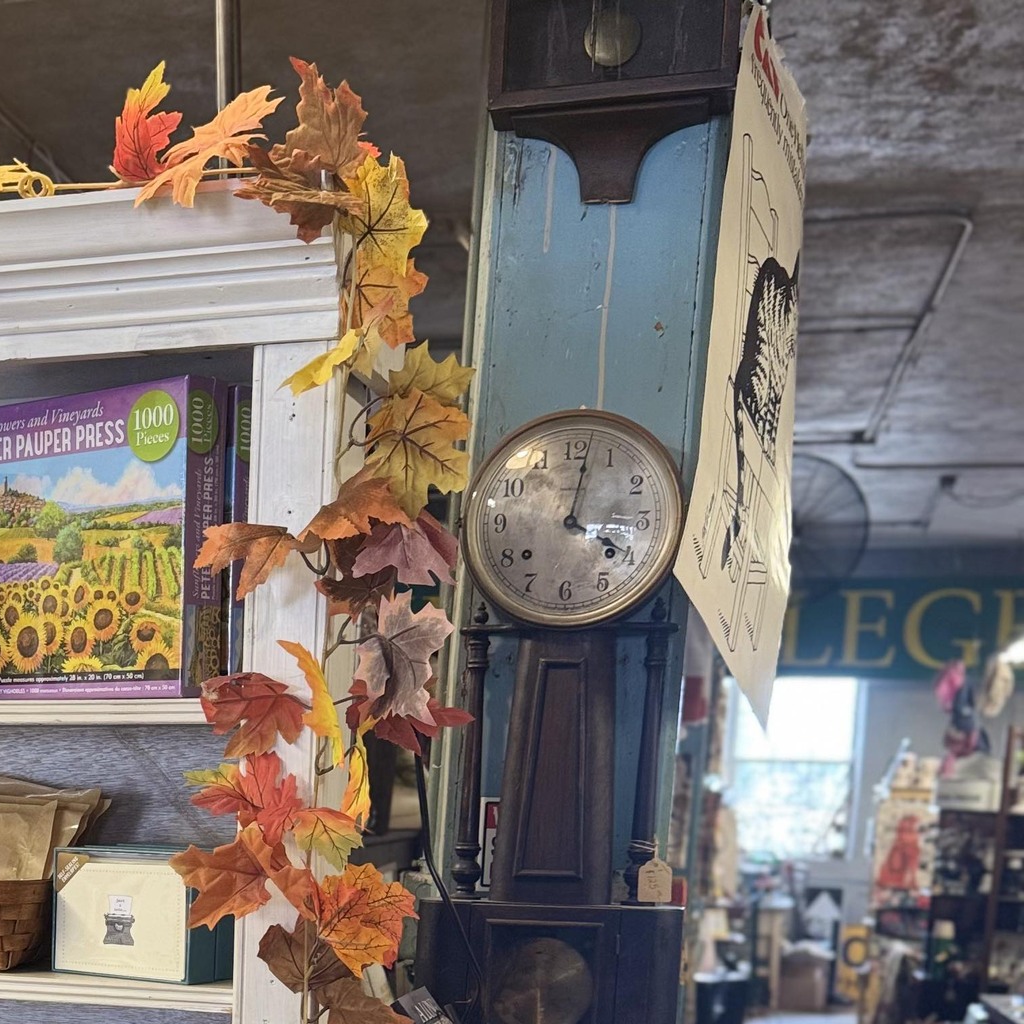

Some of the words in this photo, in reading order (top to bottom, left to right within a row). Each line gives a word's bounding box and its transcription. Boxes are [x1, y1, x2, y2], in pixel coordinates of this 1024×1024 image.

[28, 410, 48, 428] and
[51, 401, 104, 426] Vineyards
[132, 404, 174, 430] 1000
[191, 397, 204, 444] 1000
[16, 428, 72, 458] PAUPER
[76, 419, 125, 450] PRESS
[136, 431, 170, 446] Pieces
[564, 440, 587, 460] 12
[606, 448, 614, 467] 1
[204, 456, 214, 493] PRESS
[630, 475, 644, 494] 2
[503, 478, 524, 498] 10
[494, 514, 506, 534] 9
[636, 510, 650, 530] 3
[501, 549, 514, 568] 8
[622, 546, 636, 566] 4
[524, 573, 538, 592] 7
[559, 580, 572, 600] 6
[596, 572, 609, 592] 5
